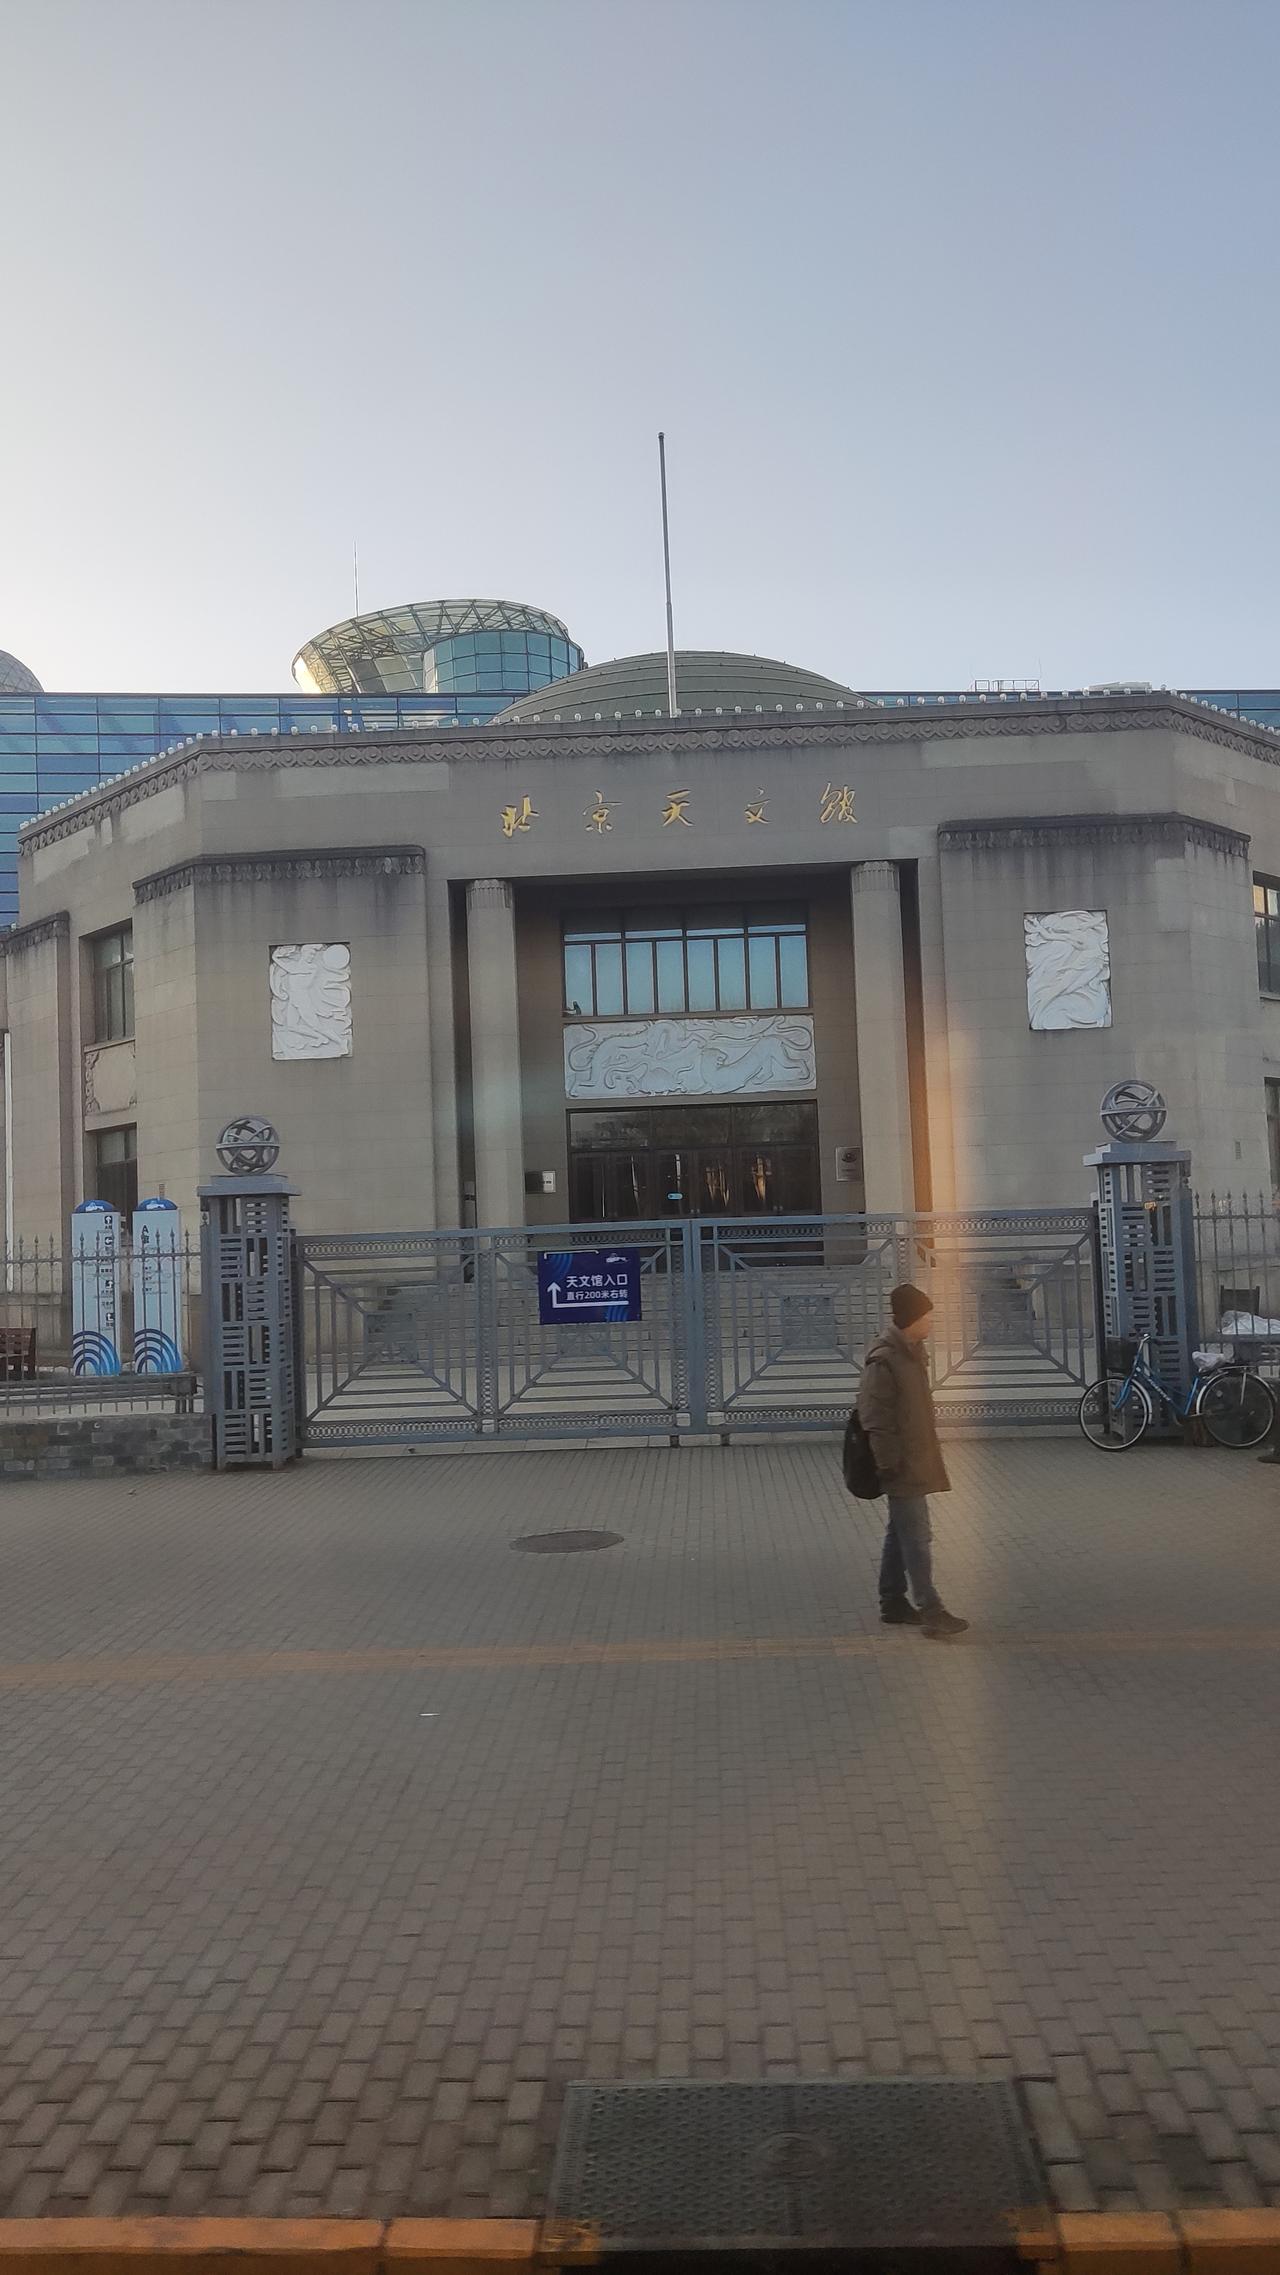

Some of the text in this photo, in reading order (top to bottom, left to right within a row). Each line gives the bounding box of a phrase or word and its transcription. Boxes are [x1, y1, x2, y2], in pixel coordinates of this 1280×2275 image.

[566, 1274, 628, 1288] 天文馆入口
[566, 1290, 628, 1300] 直行200米右转
